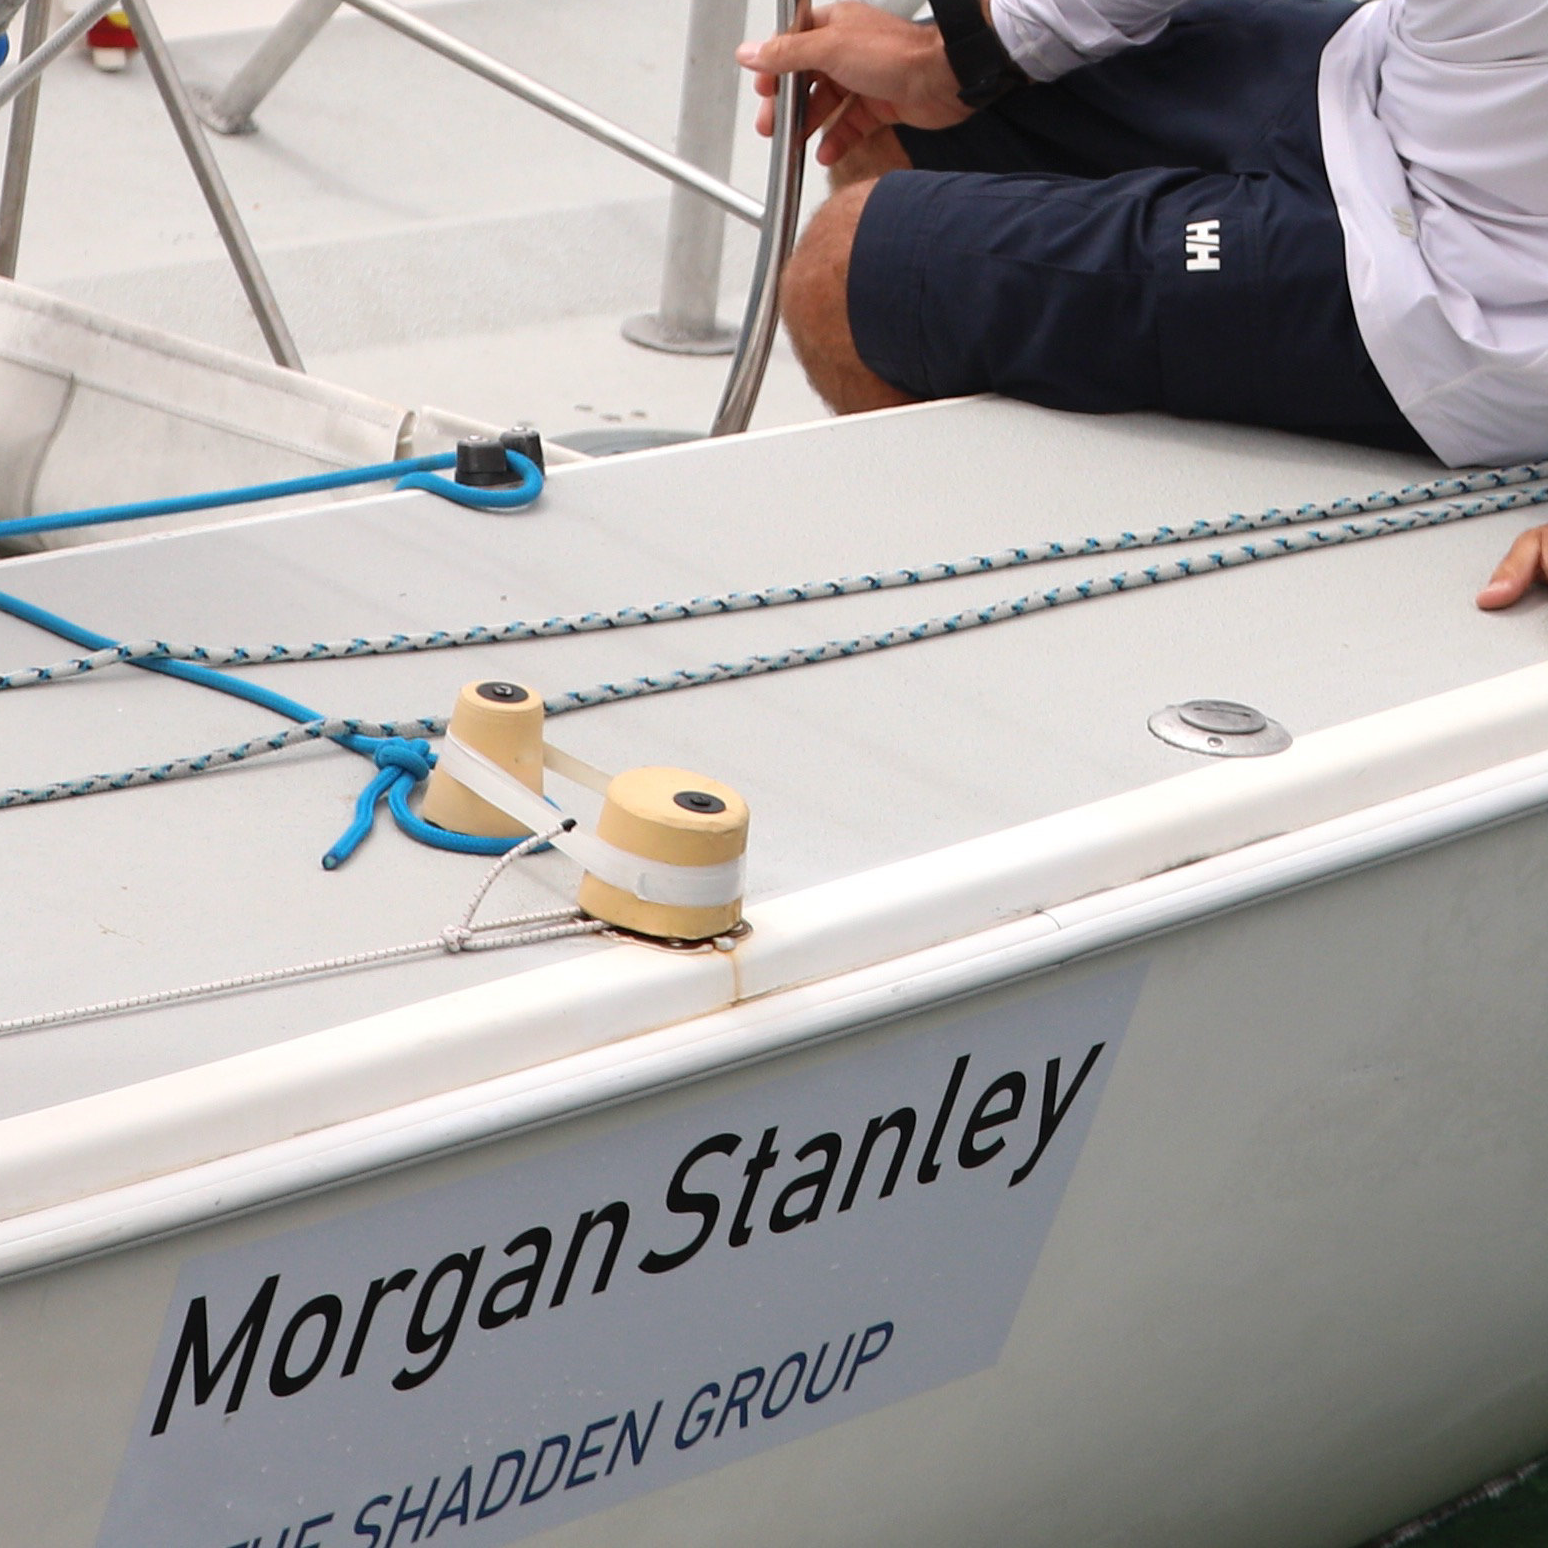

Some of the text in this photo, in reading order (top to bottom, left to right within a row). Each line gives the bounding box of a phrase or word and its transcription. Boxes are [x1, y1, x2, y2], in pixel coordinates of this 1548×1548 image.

[1185, 219, 1221, 272] HH
[151, 1043, 1106, 1437] Morgan Stanley
[353, 1321, 895, 1548] SHADDEN GROUP
